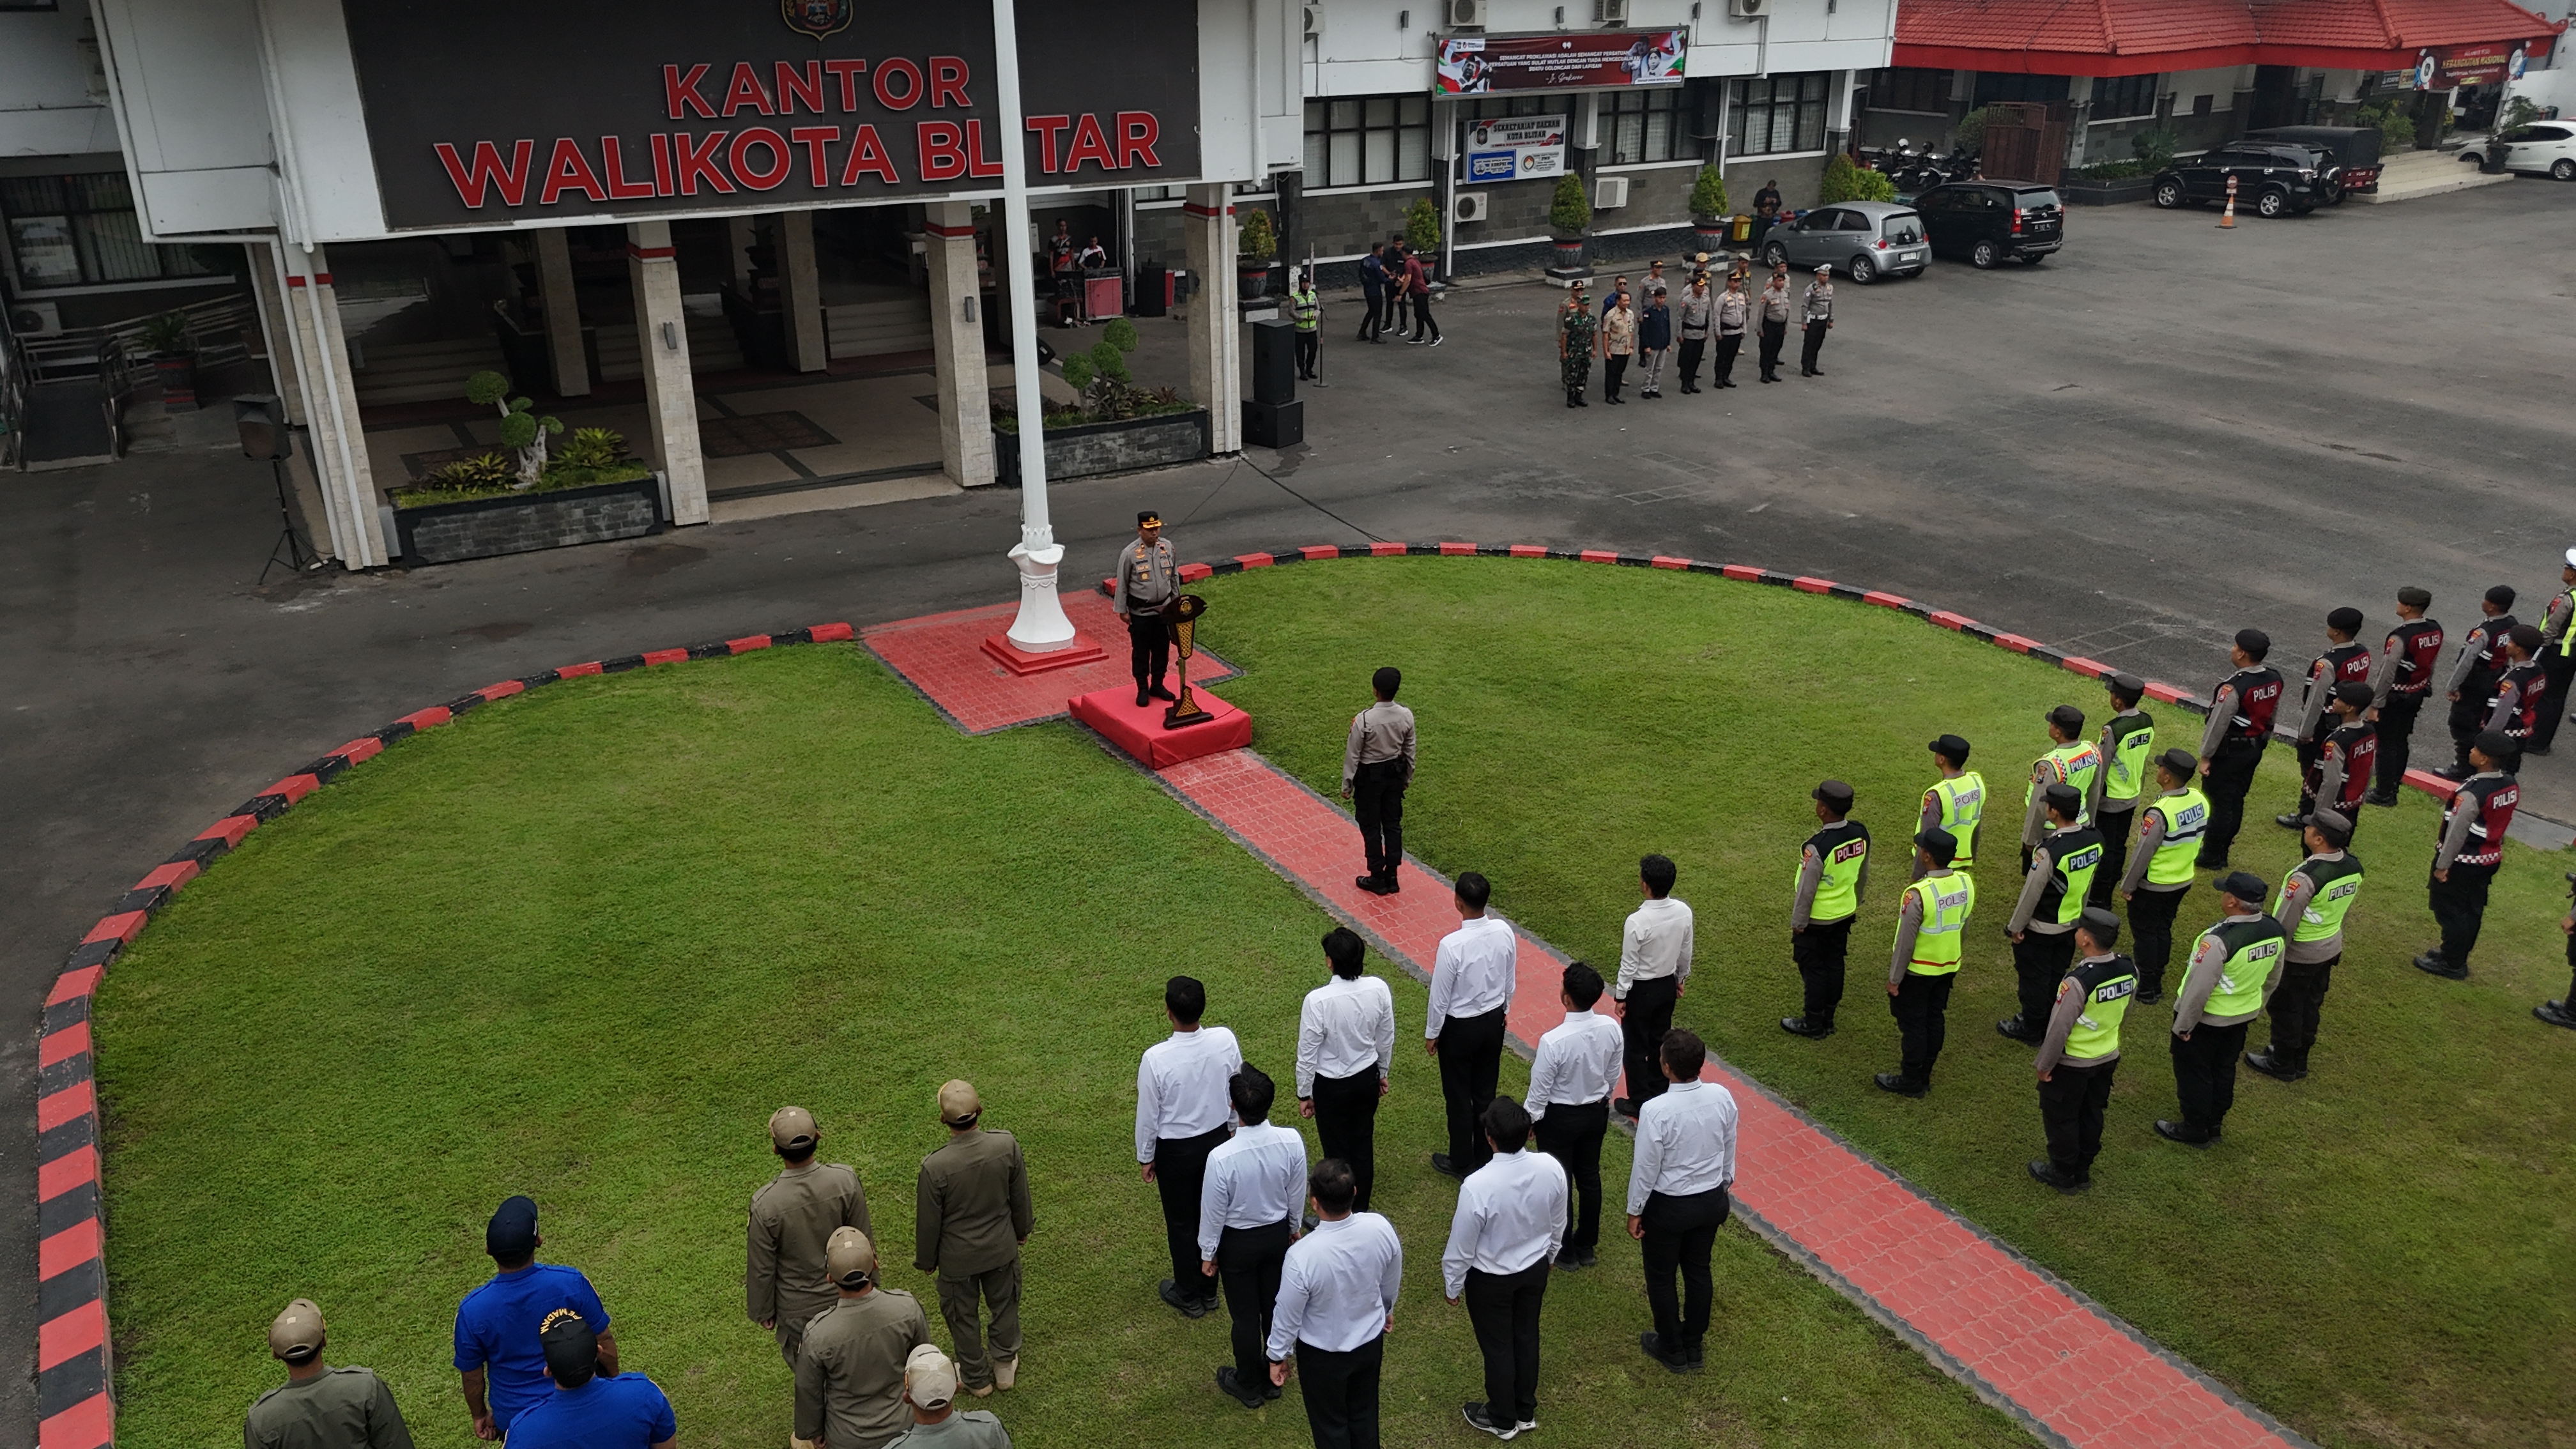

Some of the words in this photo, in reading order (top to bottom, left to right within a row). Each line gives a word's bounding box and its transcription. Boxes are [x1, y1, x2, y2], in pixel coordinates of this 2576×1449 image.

[664, 56, 973, 119] KANTOR
[1493, 122, 1535, 132] SEKRETARIAT
[1536, 119, 1560, 129] DAERAH
[1506, 132, 1523, 141] KOTA
[1524, 130, 1546, 139] BLITAR
[433, 125, 901, 208] WALIKOTA
[917, 111, 1162, 181] BLTAR
[2418, 634, 2440, 648] POLISI
[2347, 656, 2370, 674] POLISI
[2253, 685, 2277, 702] POLISI
[2354, 739, 2375, 758] POLISI
[2071, 754, 2095, 773] POLISI
[2493, 790, 2517, 809] POLISI
[1837, 841, 1864, 862] POLISI
[2071, 849, 2098, 870] POLISI
[1938, 892, 1968, 908] POLSI
[2098, 980, 2133, 1001] POLISI
[540, 1308, 582, 1335] PEMADAM
